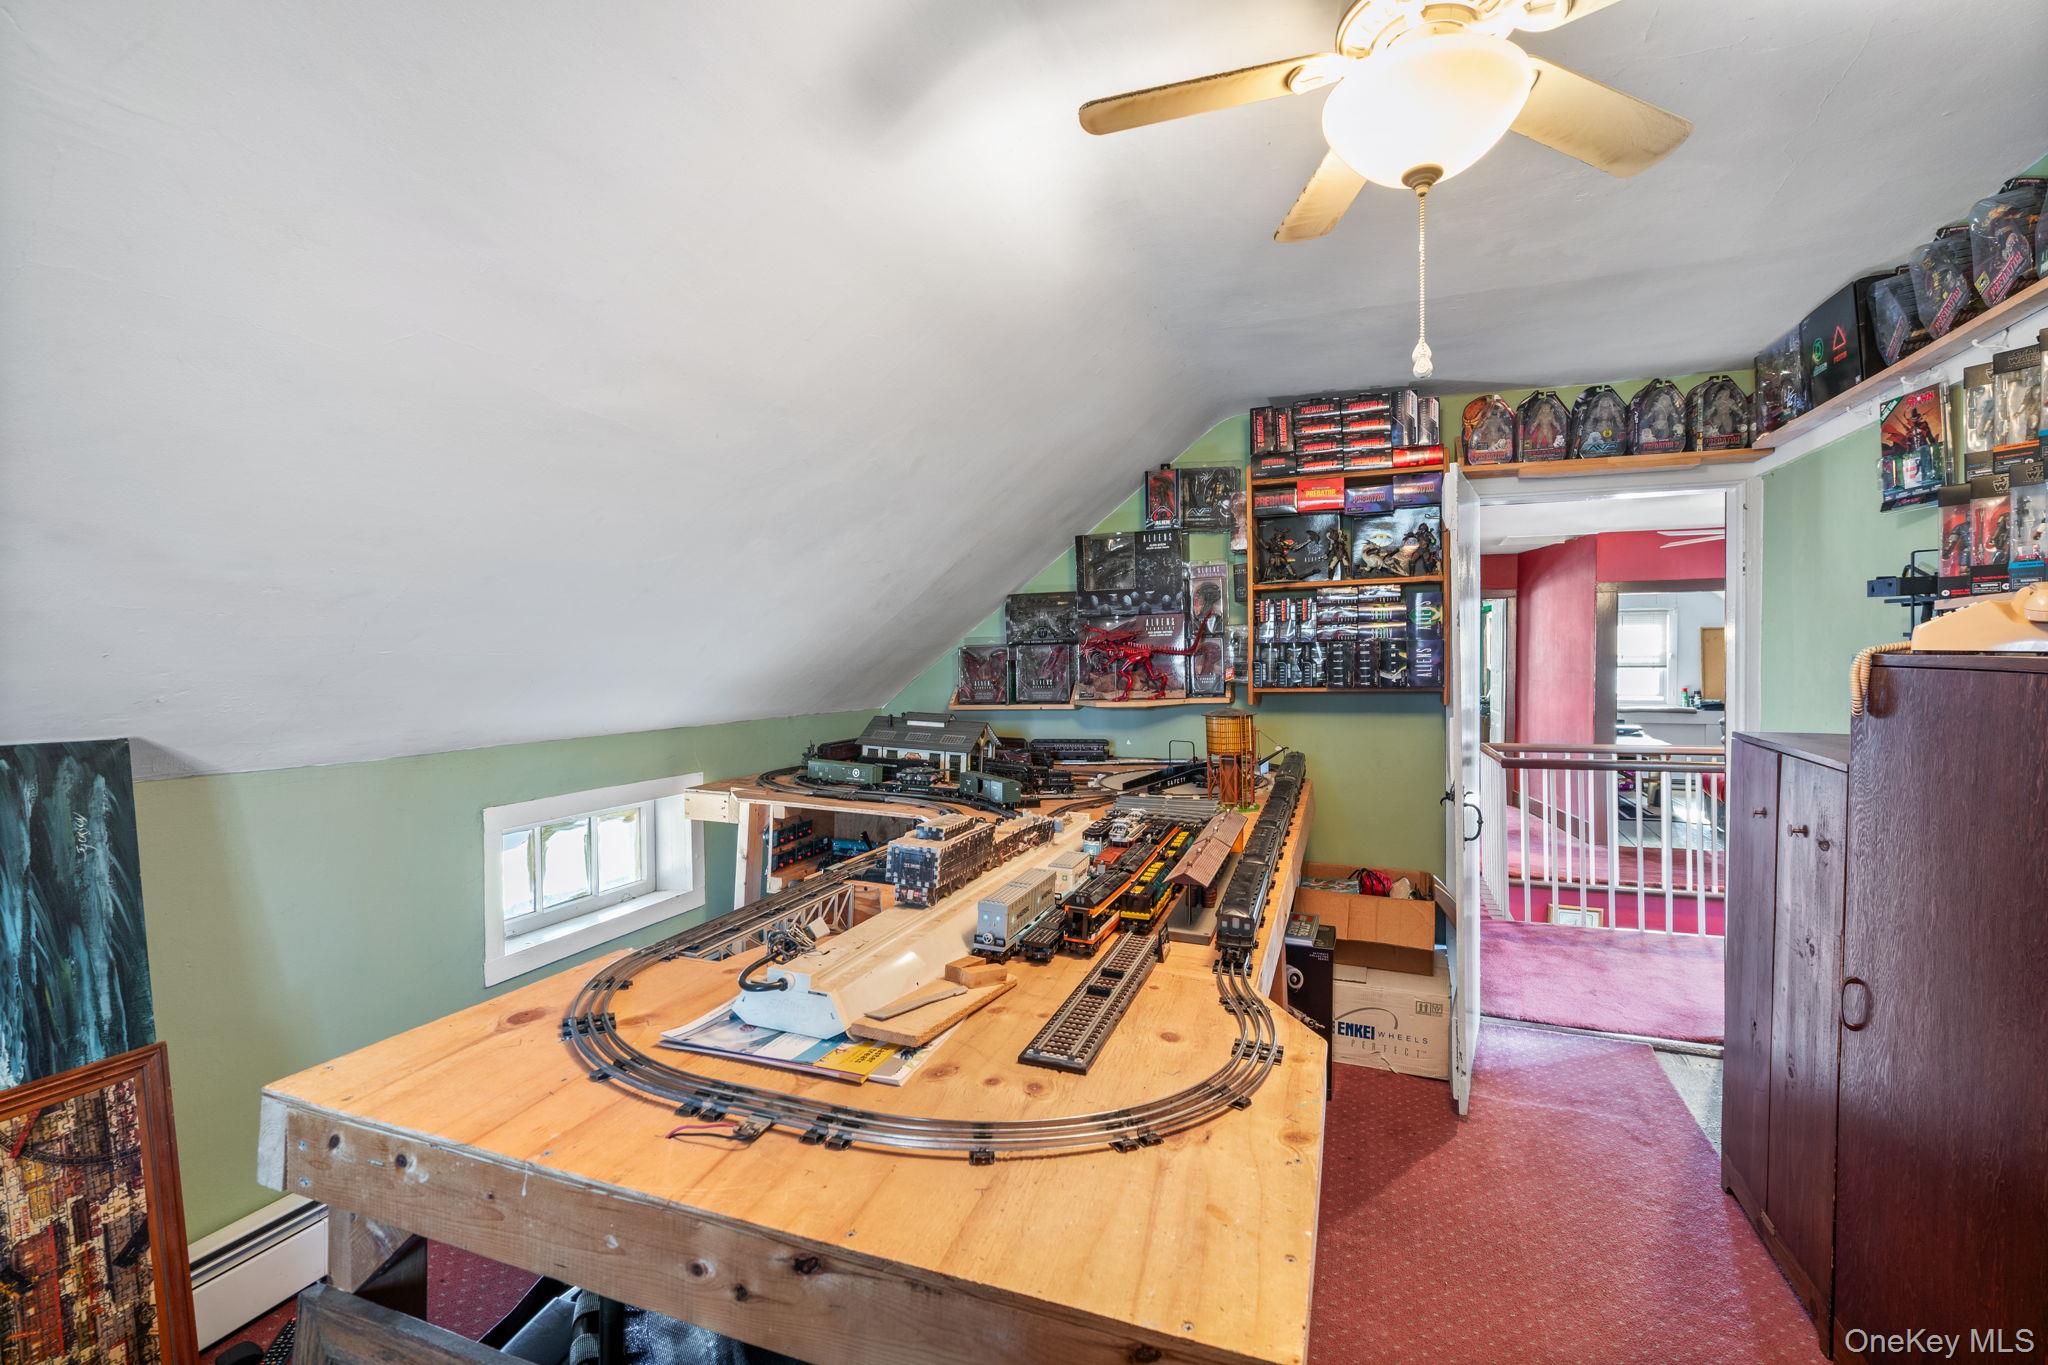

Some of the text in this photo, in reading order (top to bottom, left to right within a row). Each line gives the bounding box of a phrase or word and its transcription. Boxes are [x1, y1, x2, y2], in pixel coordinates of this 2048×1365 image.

[1305, 488, 1337, 498] PREDATOR
[1142, 532, 1172, 543] ALIENS
[1145, 617, 1175, 627] ALIENS
[1415, 647, 1433, 678] ALIENS
[1167, 777, 1186, 787] SAFETY
[1337, 1021, 1429, 1044] ENKEI WHEELS
